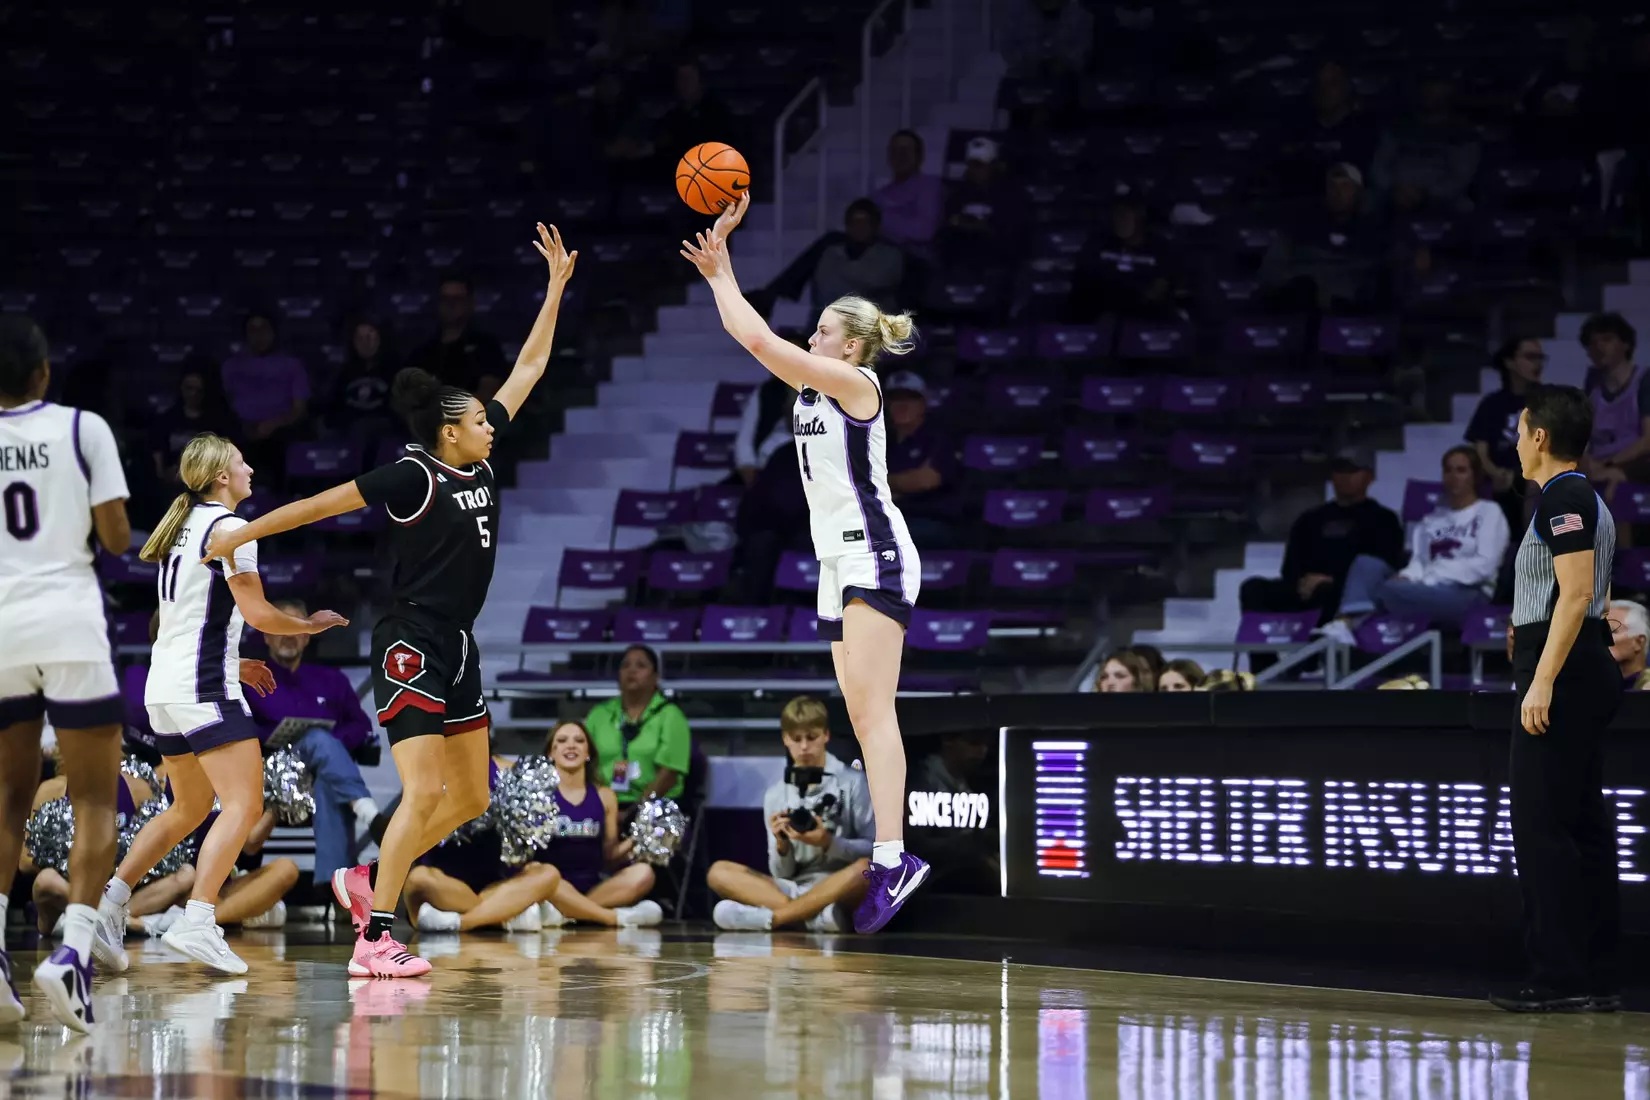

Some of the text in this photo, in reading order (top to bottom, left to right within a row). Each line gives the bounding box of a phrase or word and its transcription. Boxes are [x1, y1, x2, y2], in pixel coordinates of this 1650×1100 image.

[0, 442, 50, 471] ENAS
[3, 481, 41, 541] 0
[475, 515, 491, 548] 5
[160, 552, 183, 603] 11
[908, 790, 990, 829] SINCE 1979
[1113, 776, 1650, 883] SHELTER INSURAE
